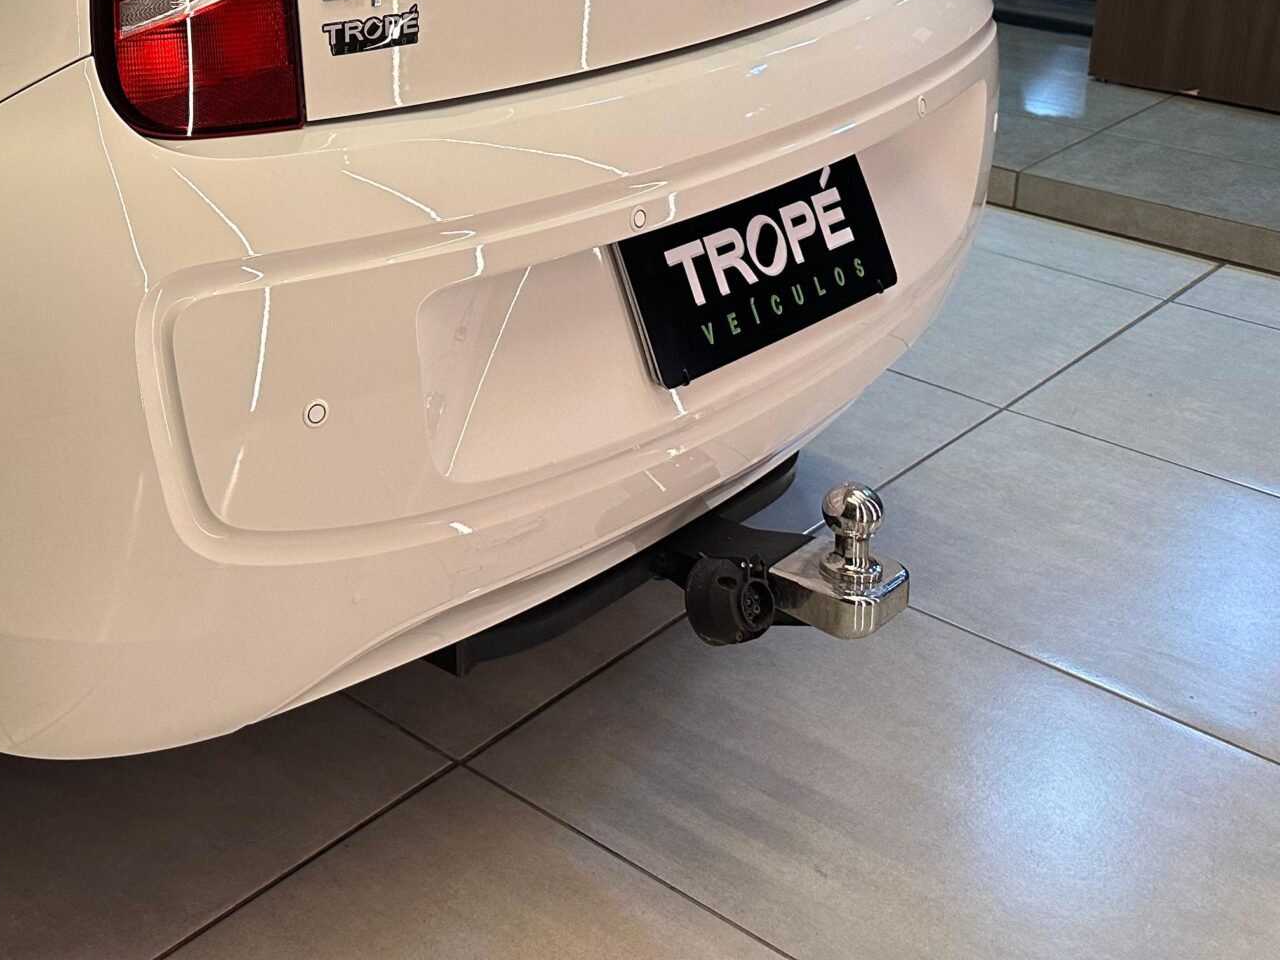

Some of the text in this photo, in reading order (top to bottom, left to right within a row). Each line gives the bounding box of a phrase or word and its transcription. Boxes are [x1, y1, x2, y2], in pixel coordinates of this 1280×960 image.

[322, 3, 419, 45] TROPÉ
[663, 164, 855, 307] TROPÉ
[700, 257, 865, 345] VEÍCULOS
